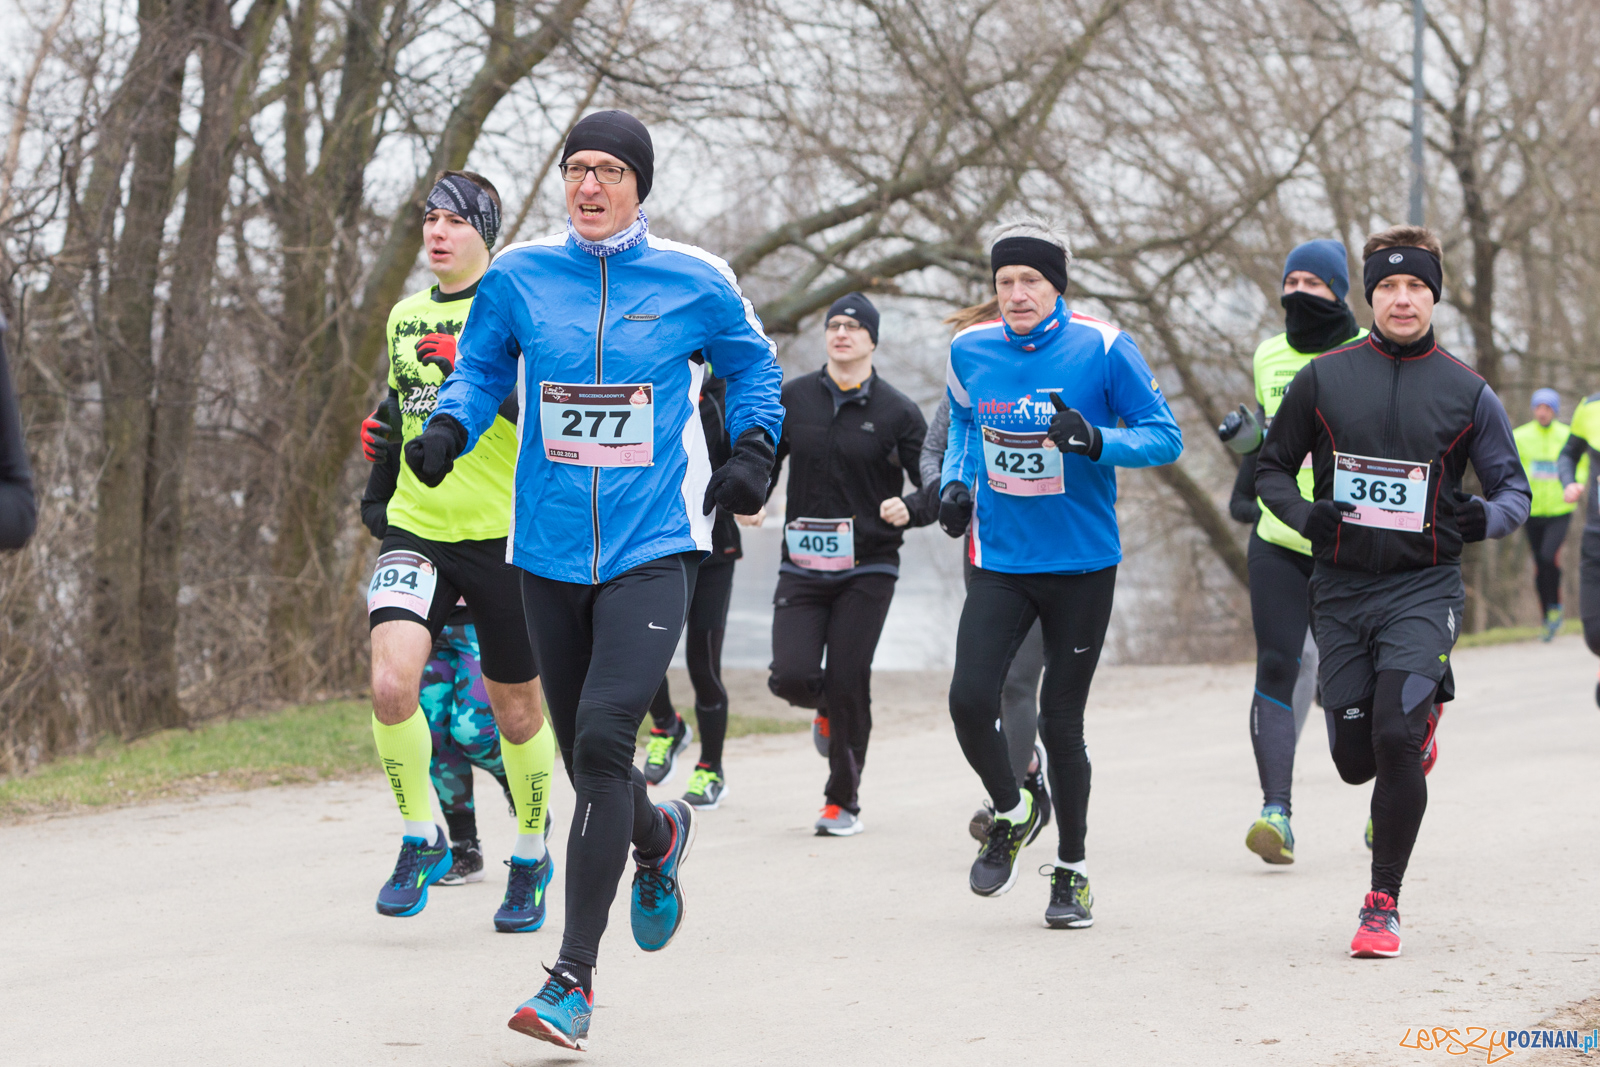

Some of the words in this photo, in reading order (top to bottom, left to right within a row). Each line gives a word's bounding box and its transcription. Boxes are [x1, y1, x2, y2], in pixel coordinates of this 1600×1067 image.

[408, 384, 441, 401] DIR
[978, 398, 1016, 414] inter
[561, 409, 631, 438] 277
[550, 450, 578, 459] 11.02.2018
[994, 450, 1045, 474] 423
[1350, 477, 1407, 505] 363
[799, 535, 839, 553] 405
[371, 568, 418, 592] 494
